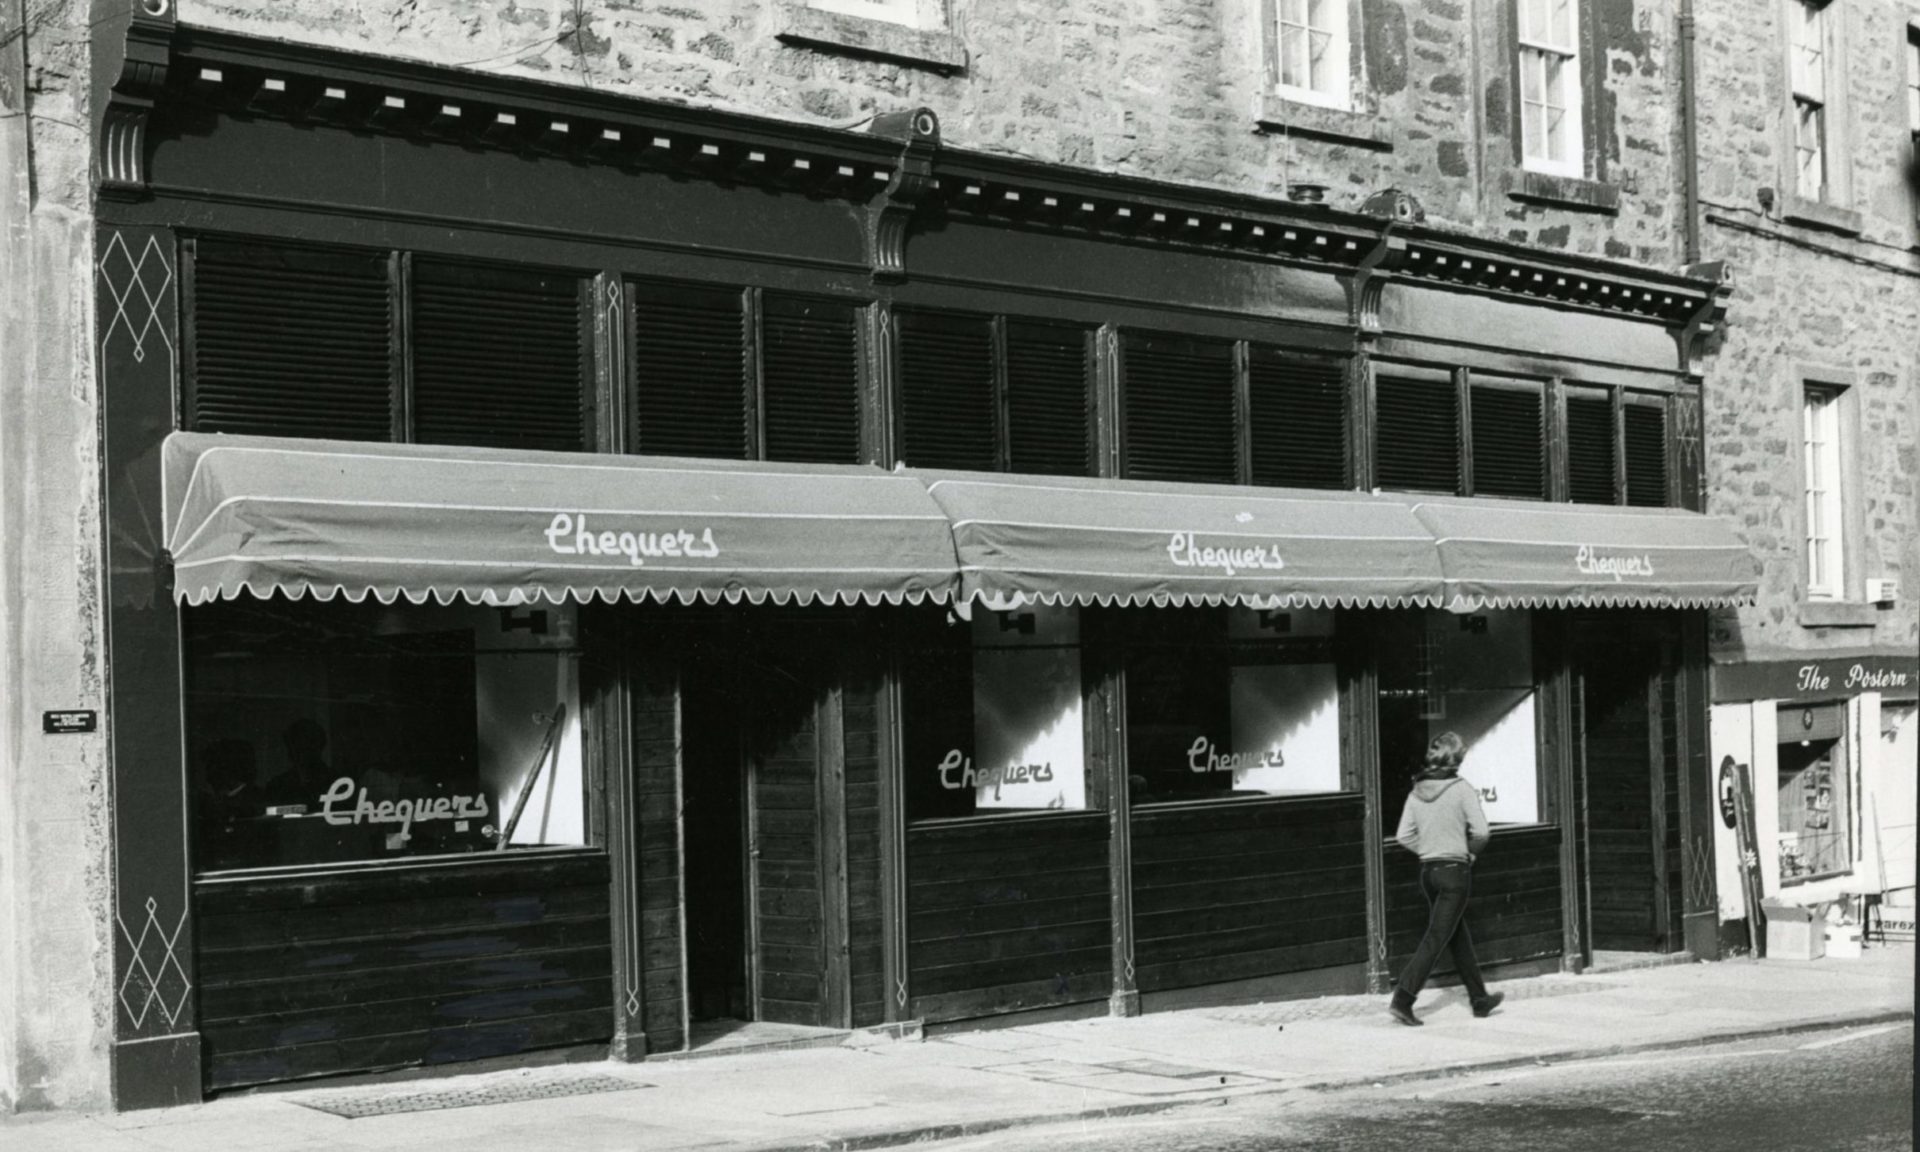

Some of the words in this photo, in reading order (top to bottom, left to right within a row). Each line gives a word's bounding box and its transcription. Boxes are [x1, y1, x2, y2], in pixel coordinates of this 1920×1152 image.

[544, 513, 719, 566] Chequers
[1167, 533, 1284, 576] Chequers
[1575, 545, 1653, 582] Chequers
[1797, 664, 1830, 691] The
[1844, 663, 1906, 689] Postern
[938, 749, 1053, 801] Chequers
[1187, 736, 1284, 784] Chequers
[319, 777, 489, 841] Chequers
